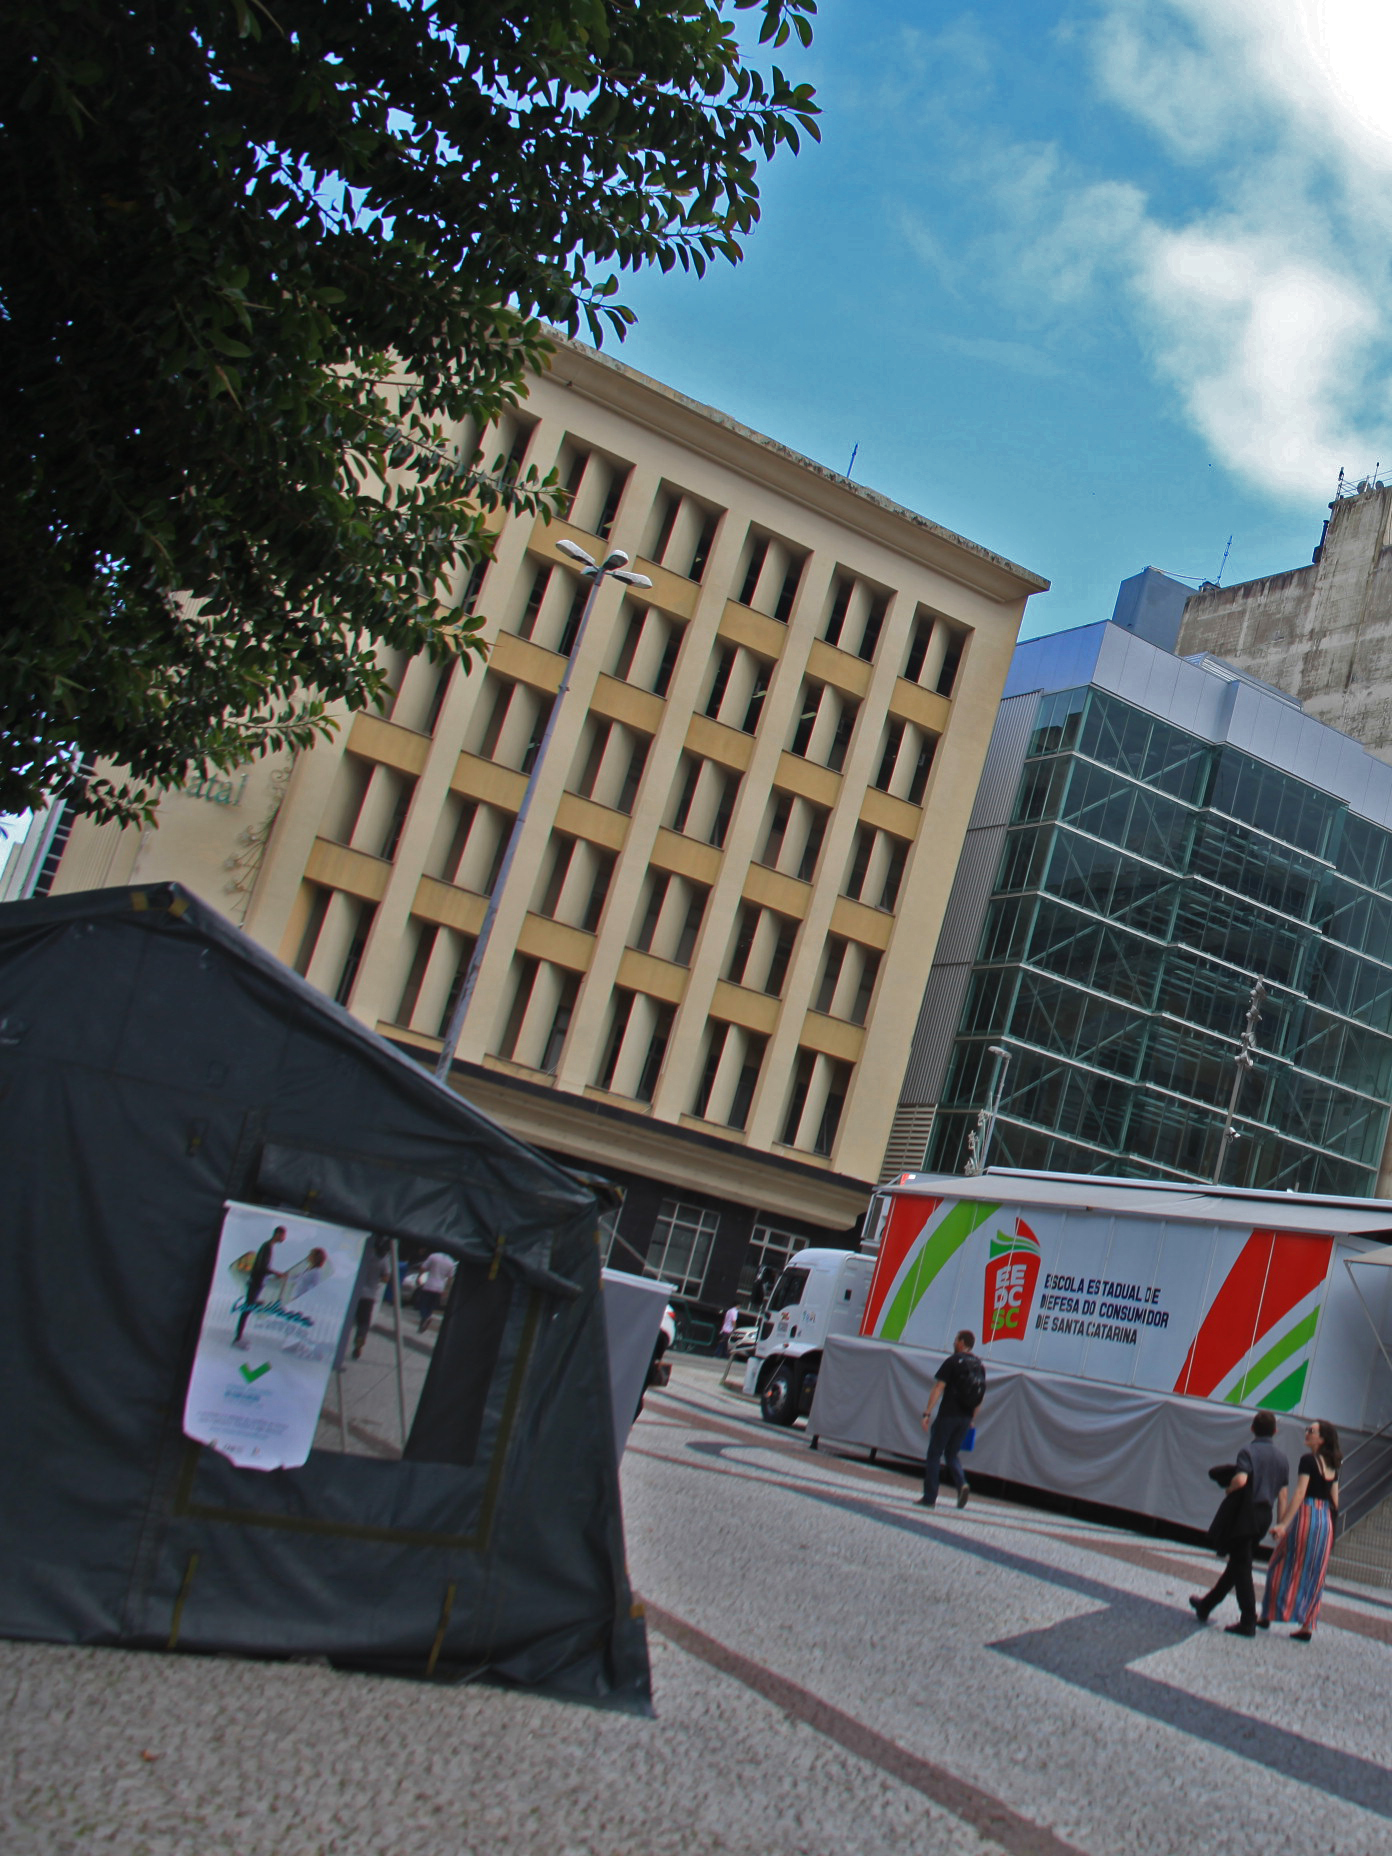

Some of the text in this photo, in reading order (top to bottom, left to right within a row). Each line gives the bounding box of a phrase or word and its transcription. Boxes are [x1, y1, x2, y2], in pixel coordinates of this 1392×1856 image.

[185, 773, 248, 806] atal
[996, 1264, 1027, 1289] EE
[1044, 1273, 1161, 1304] ESCOLA ESTADUAL DE
[994, 1286, 1023, 1310] DC
[1039, 1294, 1170, 1329] DEFESA DO CONSUMIDOR
[991, 1307, 1020, 1330] SC
[1035, 1314, 1138, 1346] DE SANTA CATARINA
